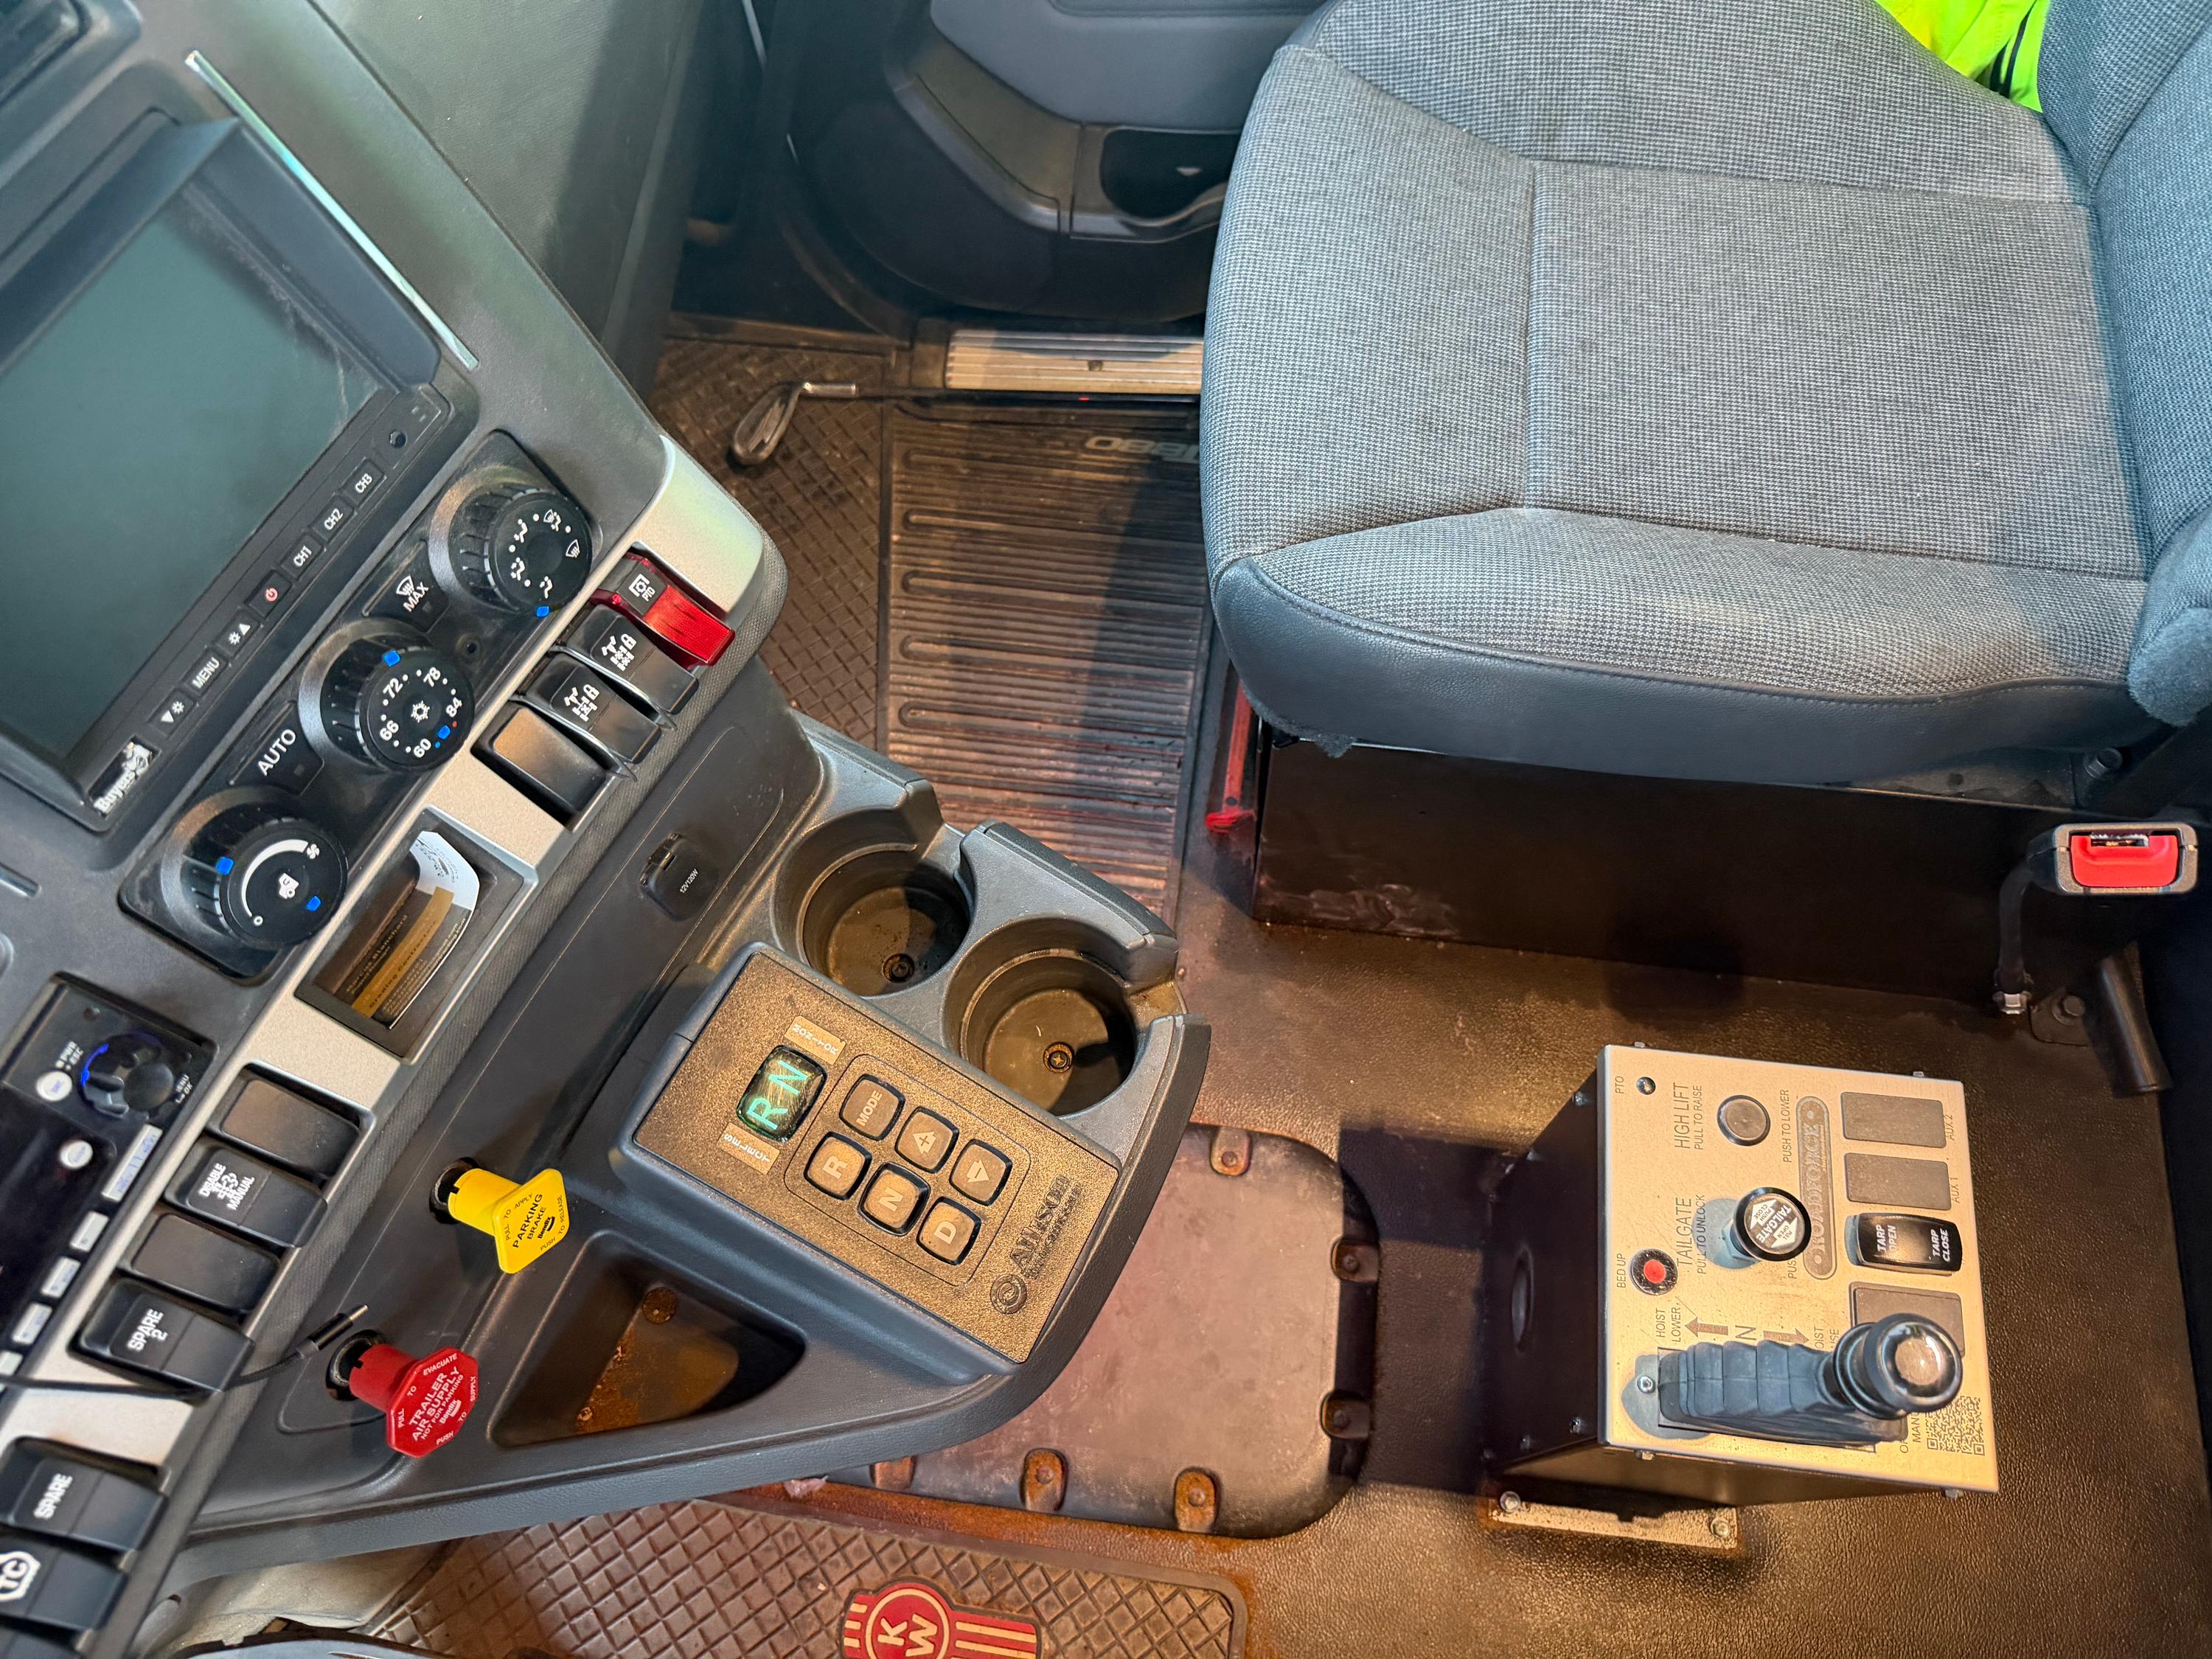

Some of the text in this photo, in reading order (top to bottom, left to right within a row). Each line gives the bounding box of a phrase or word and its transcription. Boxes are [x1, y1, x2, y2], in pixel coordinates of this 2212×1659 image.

[355, 473, 373, 493] CH3
[324, 509, 343, 531] CH2
[293, 545, 313, 567] CH1
[403, 582, 429, 613] MAX
[641, 586, 655, 602] PTO
[192, 657, 220, 689] MENU
[383, 678, 403, 698] 72
[423, 667, 441, 687] 78
[446, 697, 462, 717] 84
[380, 720, 399, 741] 66
[257, 728, 296, 776] AUTO
[414, 738, 431, 758] 60
[791, 1023, 838, 1055] MONITOR
[746, 1060, 808, 1130] R N
[1615, 1076, 1624, 1094] PTO
[856, 1090, 883, 1127] MODE
[1673, 1082, 1691, 1150] HIGH LIFT
[1693, 1085, 1704, 1150] PULL TO RAISE
[1781, 1089, 1792, 1163] PUSH TO LOWER
[1944, 1120, 1955, 1141] AUX
[723, 1133, 771, 1163] SELECT
[199, 1163, 226, 1197] DISABLE
[822, 1155, 849, 1180] R
[227, 1176, 255, 1210] MANUAL
[504, 1209, 511, 1219] TO
[514, 1193, 532, 1209] APPLY
[879, 1187, 904, 1212] N
[1951, 1183, 1960, 1203] AUX
[512, 1194, 543, 1248] PARKING
[527, 1207, 546, 1239] BRAKE
[1753, 1203, 1767, 1220] CLOSE
[1756, 1204, 1792, 1243] TAILGATE
[1759, 1208, 1771, 1222] PUSH
[540, 1237, 555, 1251] PUSH
[558, 1225, 565, 1234] TO
[933, 1220, 957, 1245] D
[1675, 1197, 1693, 1267] TAILGATE
[1695, 1194, 1706, 1275] PULL TO UNLOCK
[1875, 1224, 1887, 1253] TARP
[1888, 1225, 1897, 1253] OPEN
[1930, 1228, 1941, 1257] TARP
[1938, 1228, 1950, 1262] CLOSE
[1616, 1253, 1627, 1289] BED UP
[128, 1309, 164, 1352] SPARE
[152, 1330, 167, 1341] 2
[1655, 1308, 1666, 1338] HOIST
[1671, 1307, 1681, 1342] LOWER
[1735, 1325, 1757, 1340] N
[1814, 1324, 1824, 1349] OIST
[1829, 1329, 1840, 1349] ISE
[407, 1385, 417, 1397] TO
[422, 1353, 457, 1376] EVACUATE
[408, 1373, 448, 1426] TRAILER
[412, 1366, 459, 1441] AIR SUPPLY
[420, 1374, 464, 1440] NOT FOR PARKING
[439, 1399, 458, 1425] Bendix
[436, 1430, 454, 1445] PUSH
[458, 1411, 467, 1422] TO
[33, 1473, 72, 1520] SPARE
